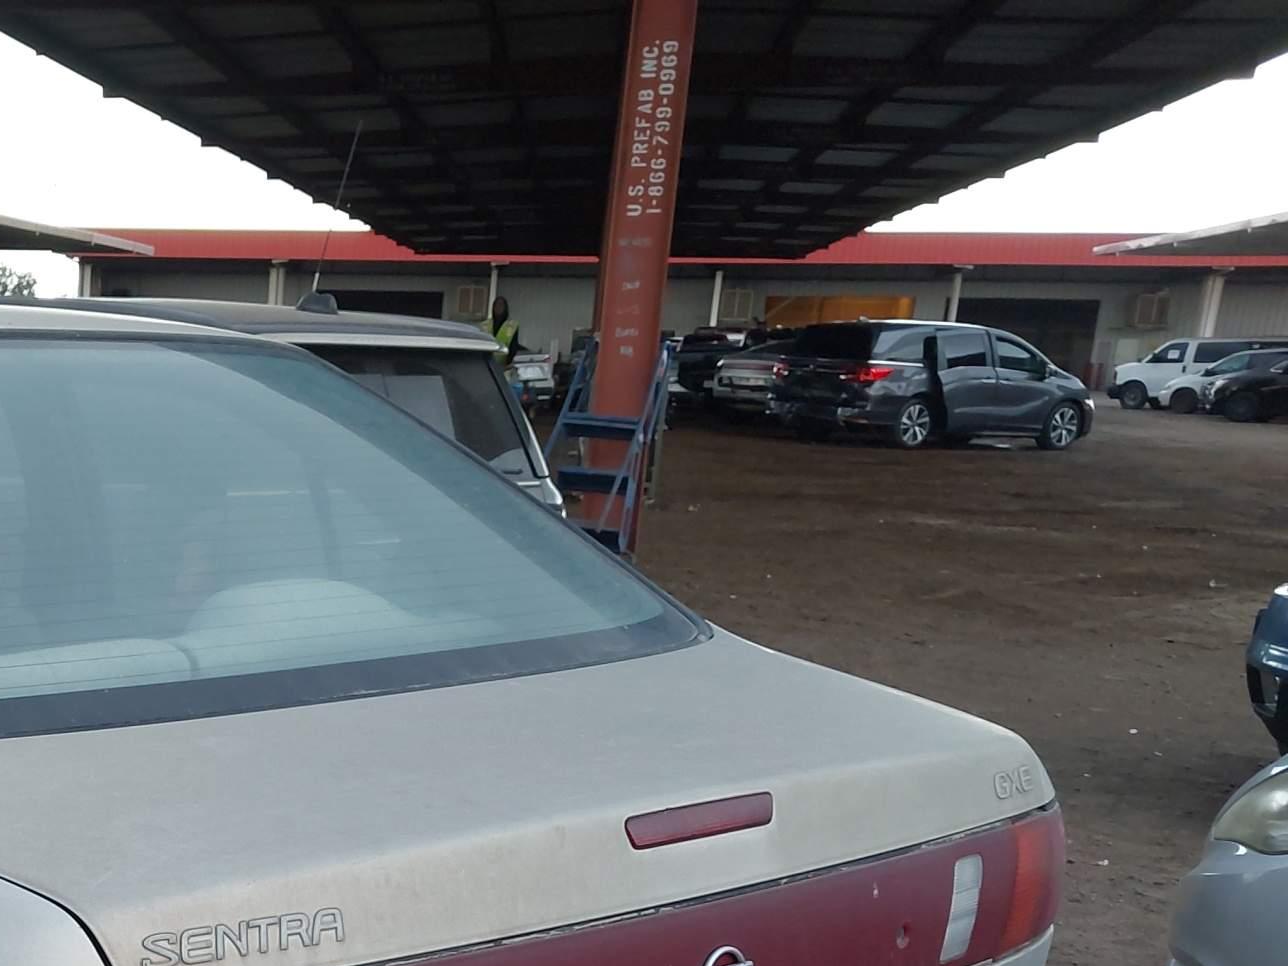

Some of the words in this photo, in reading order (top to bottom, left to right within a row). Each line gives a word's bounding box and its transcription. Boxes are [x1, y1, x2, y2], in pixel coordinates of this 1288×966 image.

[640, 39, 661, 78] INC.
[631, 89, 655, 167] PREFAB
[646, 40, 679, 213] 1-866-799-0969
[626, 179, 645, 217] U.S.
[993, 764, 1034, 800] GXE
